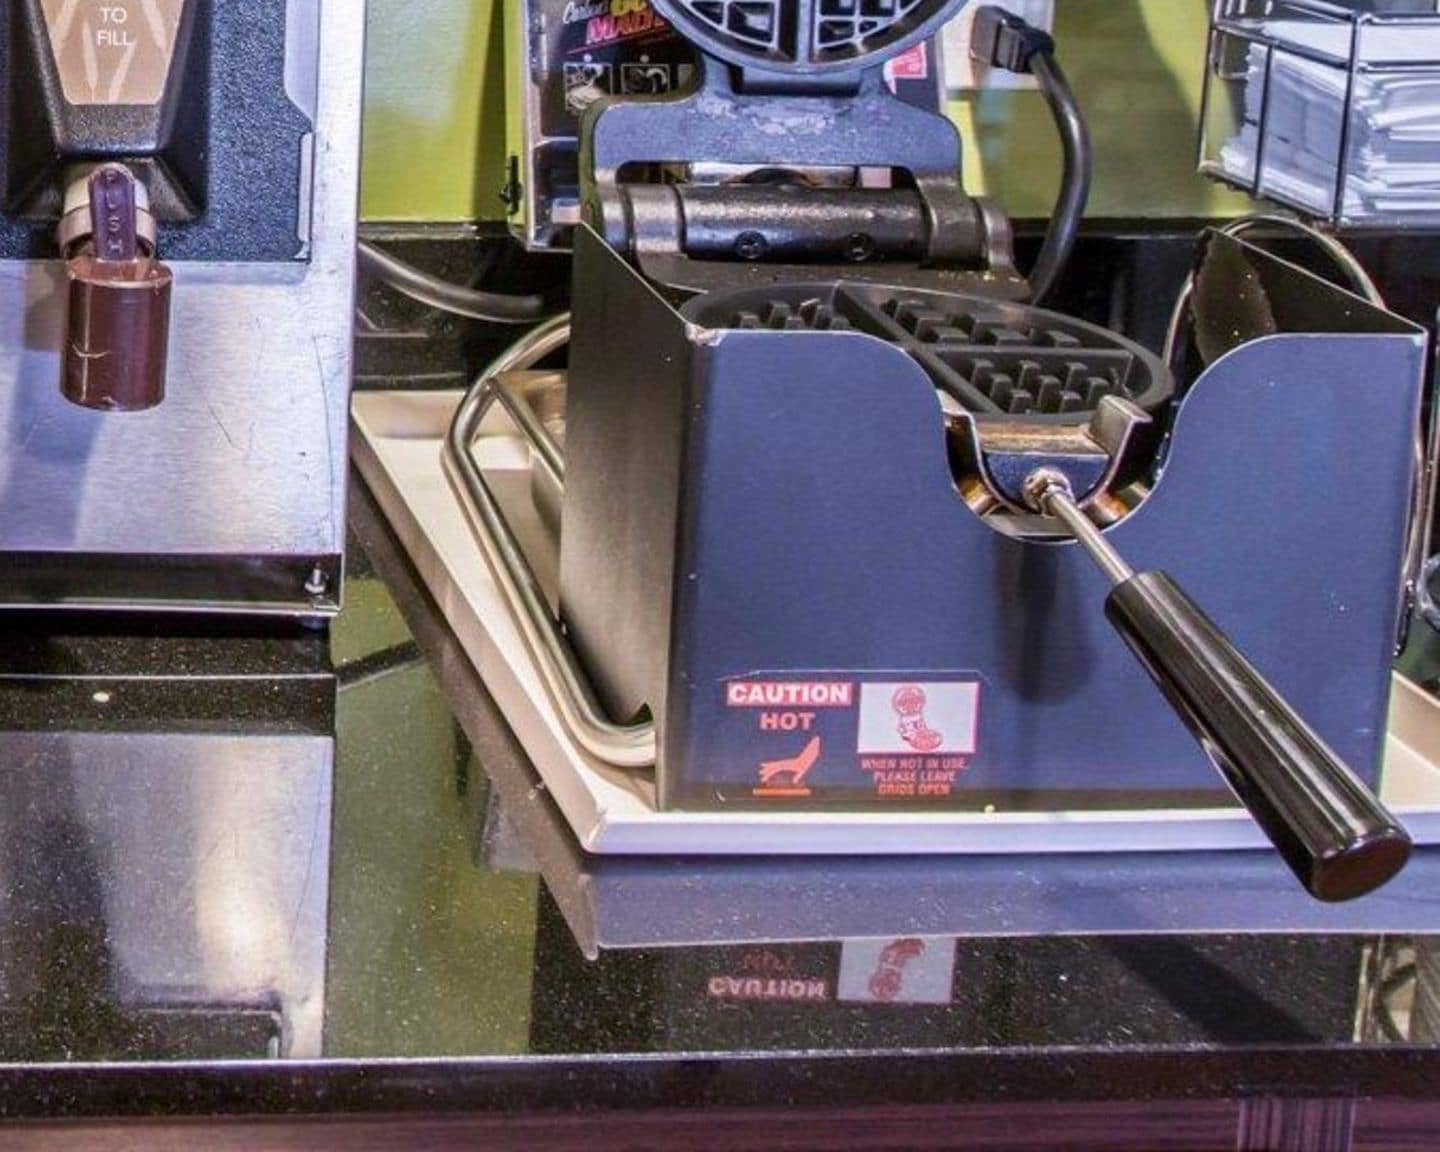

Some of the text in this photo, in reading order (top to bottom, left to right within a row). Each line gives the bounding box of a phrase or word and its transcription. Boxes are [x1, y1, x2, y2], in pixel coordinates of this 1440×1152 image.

[99, 6, 128, 24] TO
[96, 29, 133, 47] FILL
[728, 683, 850, 704] CAUTION
[760, 712, 816, 731] HOT
[861, 758, 897, 770] WHEN
[926, 758, 940, 769] IN
[873, 770, 957, 783] PLEASE LEAVE
[918, 783, 951, 796] OPEN
